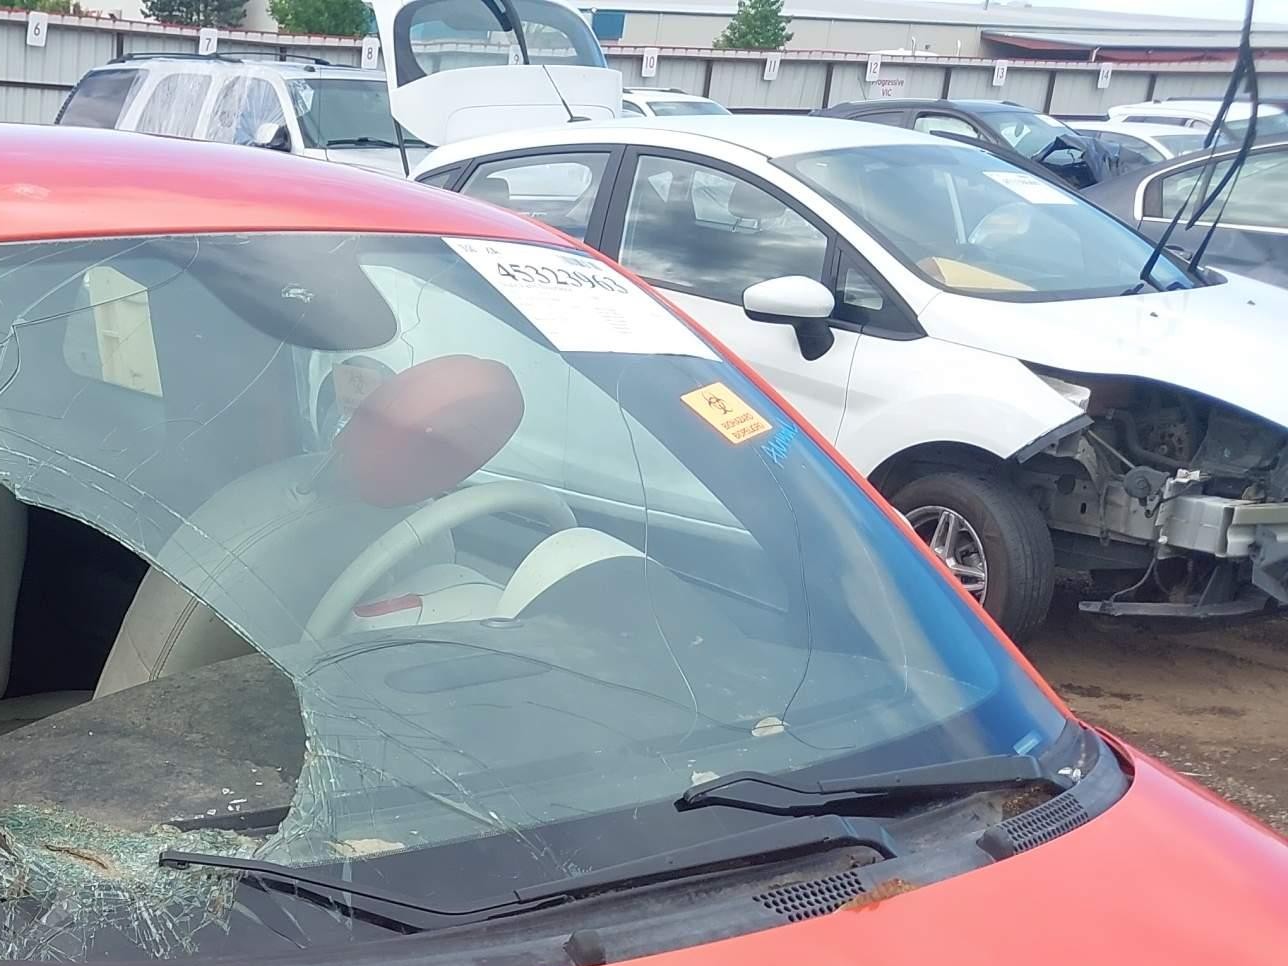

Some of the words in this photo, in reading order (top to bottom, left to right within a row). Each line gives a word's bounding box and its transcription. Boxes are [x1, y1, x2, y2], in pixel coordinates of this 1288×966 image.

[33, 22, 41, 37] 6
[205, 37, 213, 52] 7
[366, 46, 374, 60] 8
[513, 53, 521, 65] 9
[645, 55, 655, 69] 10
[768, 60, 777, 73] 11
[869, 62, 879, 75] 12
[996, 67, 1005, 79] 13
[881, 88, 893, 97] VIC
[496, 261, 629, 296] 45323963
